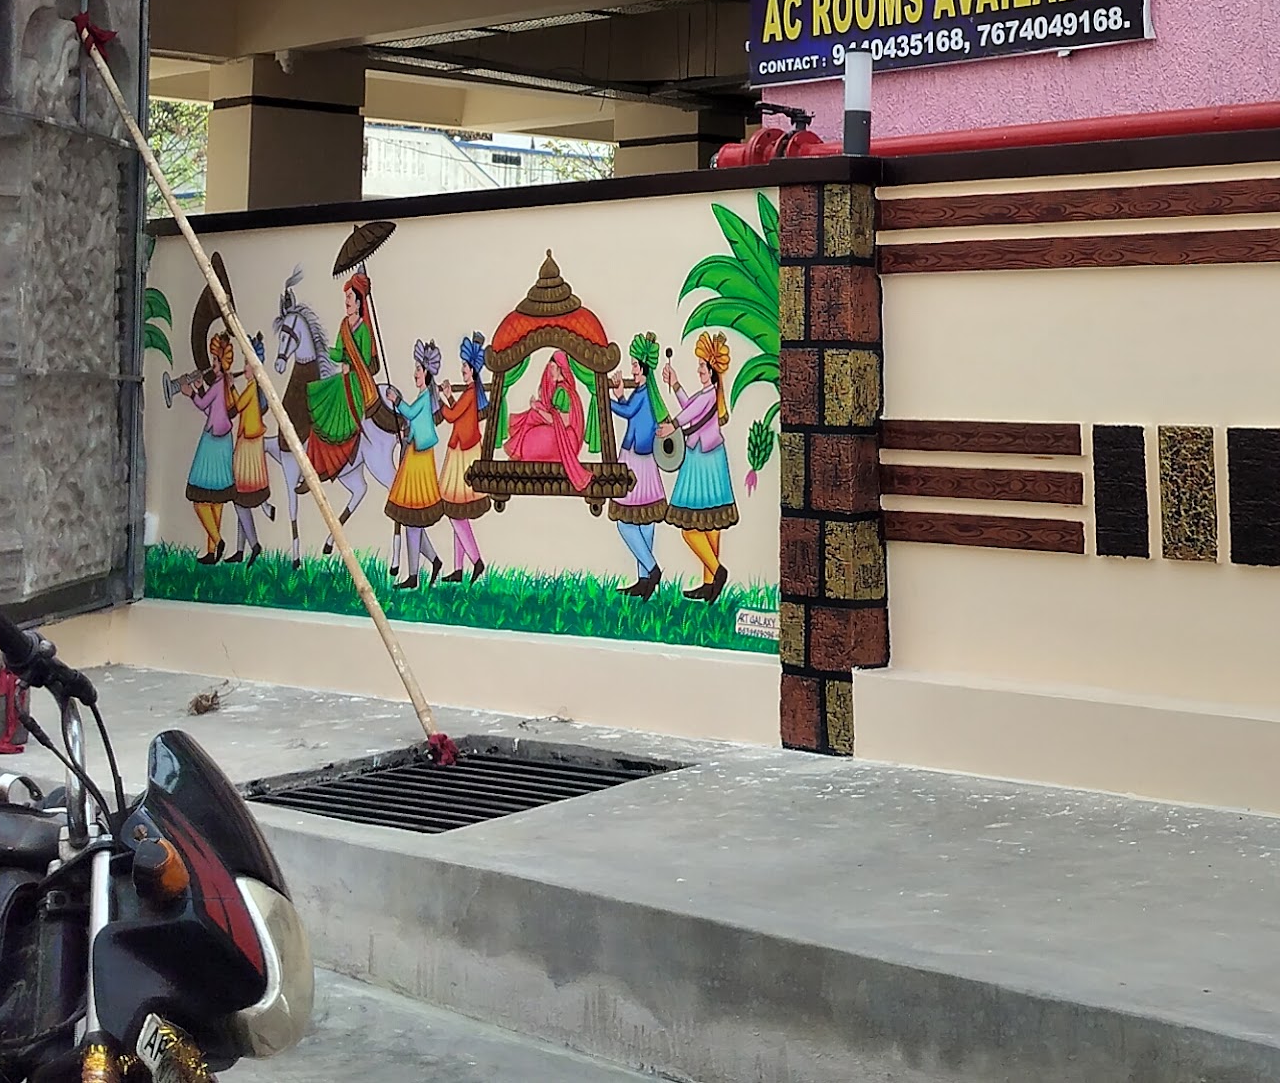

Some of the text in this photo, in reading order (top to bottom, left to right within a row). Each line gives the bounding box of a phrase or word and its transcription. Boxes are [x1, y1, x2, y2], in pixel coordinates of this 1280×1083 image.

[758, 55, 819, 74] CONTACT
[832, 27, 971, 67] 90435168,
[977, 7, 1131, 48] 7674049168.
